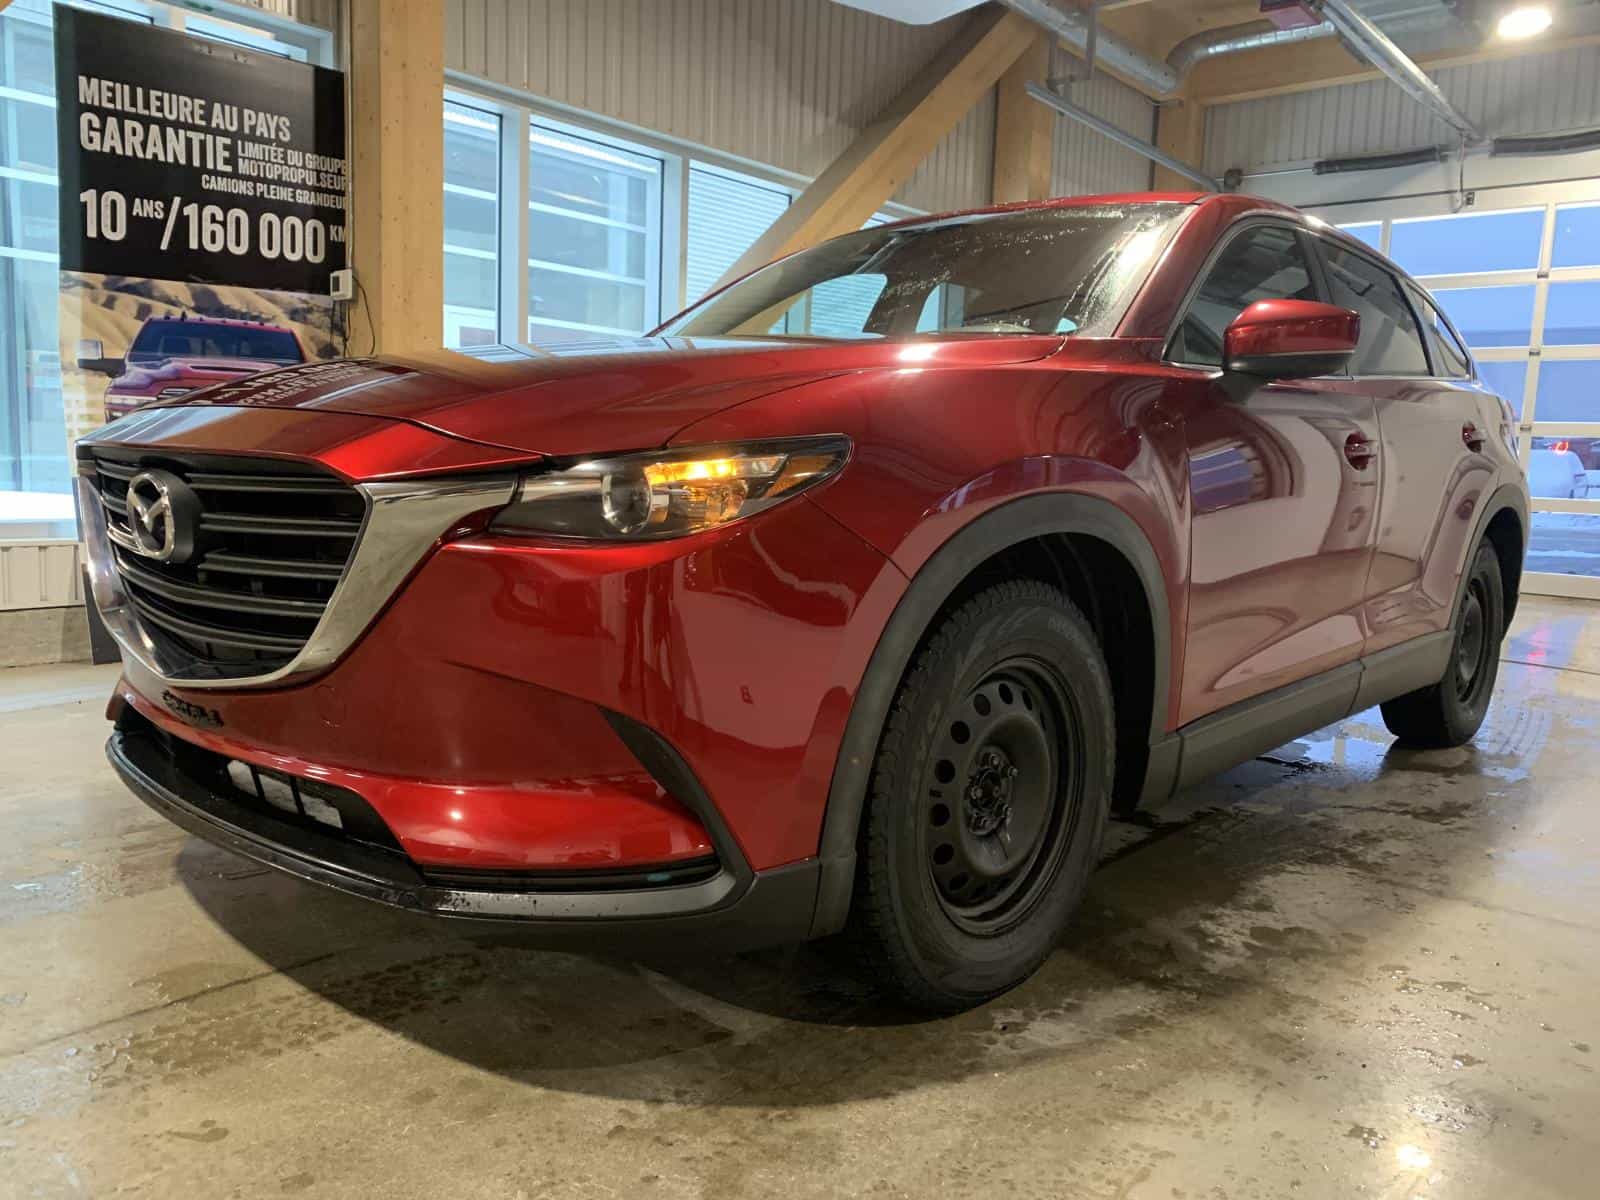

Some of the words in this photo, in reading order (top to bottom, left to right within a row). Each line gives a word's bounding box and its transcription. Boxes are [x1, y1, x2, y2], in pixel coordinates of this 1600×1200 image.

[78, 75, 206, 126] MEILLEURE
[211, 102, 238, 133] AU
[243, 109, 291, 142] PAYS
[79, 112, 232, 173] GARANTIE
[238, 140, 285, 164] LIMITÉE
[287, 149, 303, 168] DU
[202, 174, 254, 196] CAMIONS
[256, 182, 295, 202] PLEINE
[295, 189, 346, 209] GRANDEU
[80, 189, 126, 241] 10
[132, 198, 164, 219] ANS
[259, 212, 325, 263] 000
